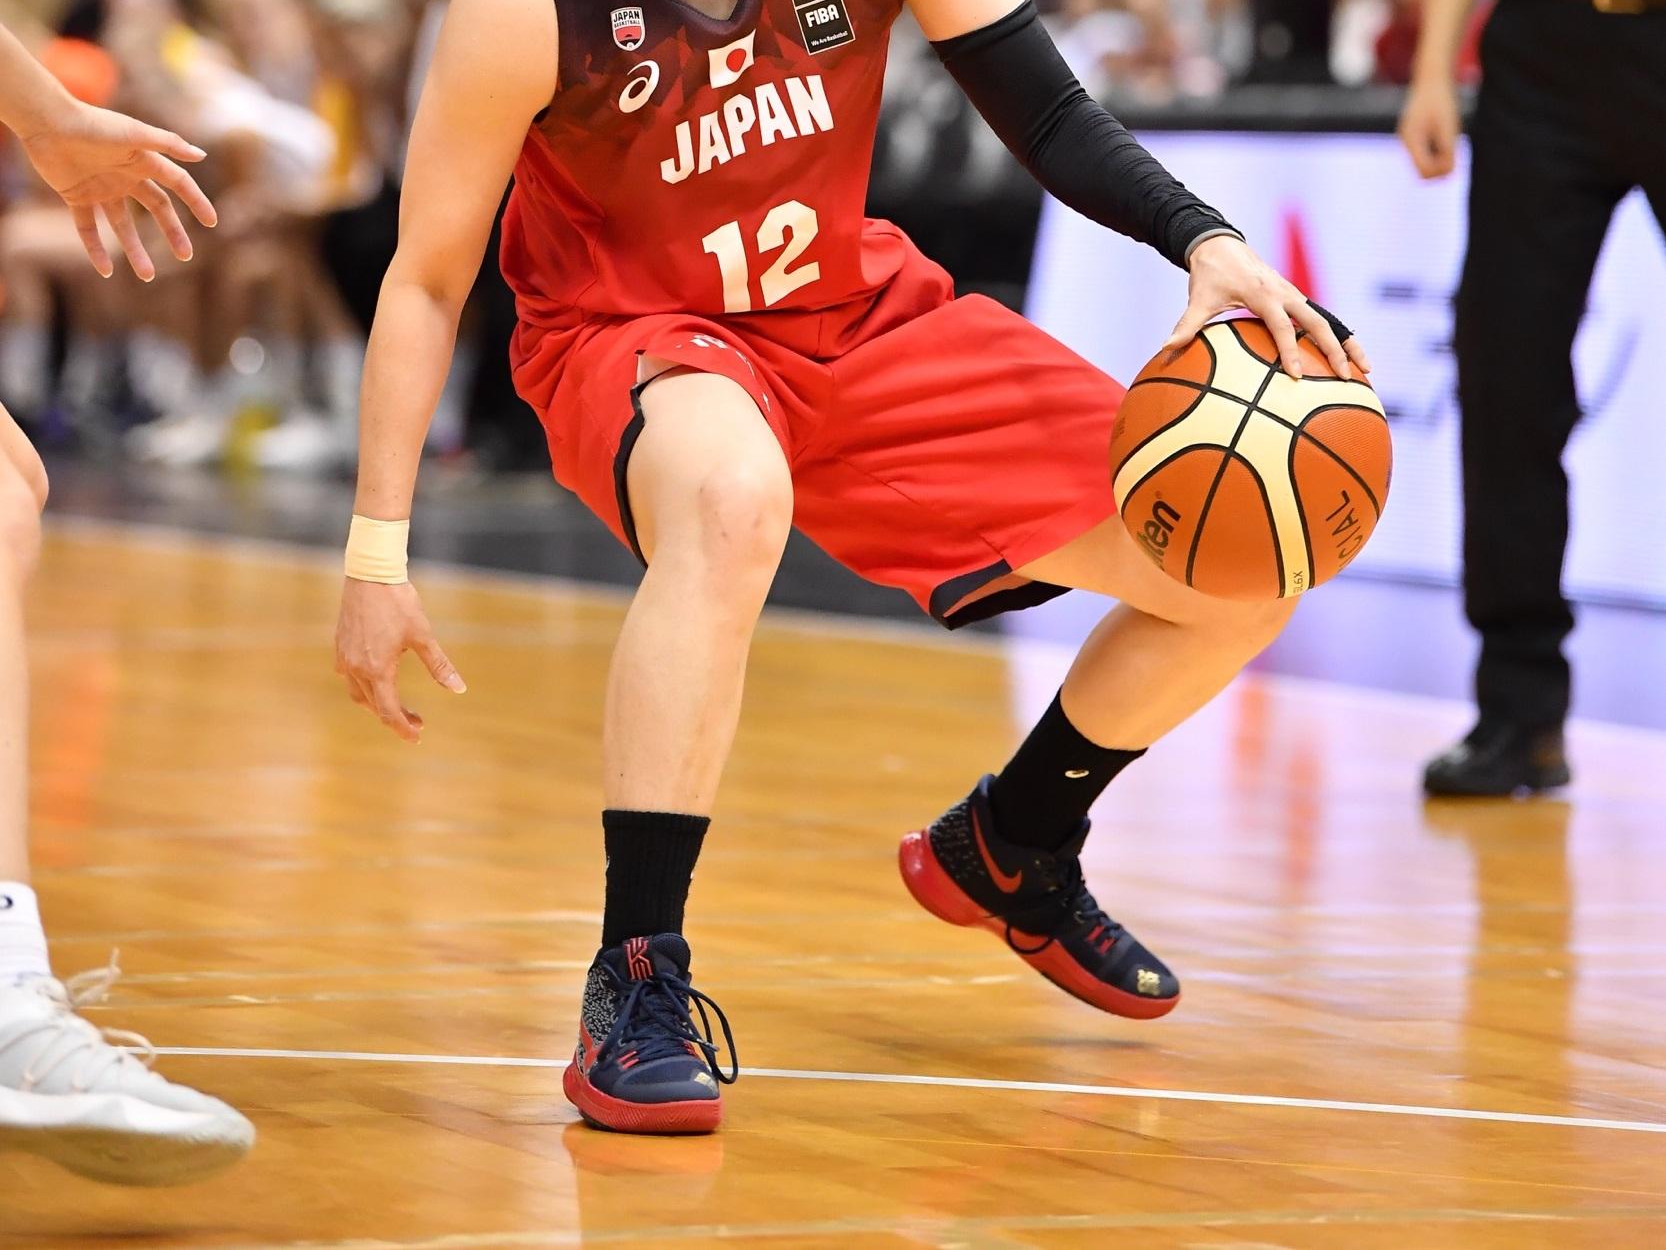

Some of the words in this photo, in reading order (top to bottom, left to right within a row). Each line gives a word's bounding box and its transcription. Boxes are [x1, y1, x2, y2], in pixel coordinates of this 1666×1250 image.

[613, 11, 640, 22] JAPAN
[805, 4, 839, 27] FIBA
[660, 74, 834, 185] JAPAN
[701, 199, 820, 313] 12
